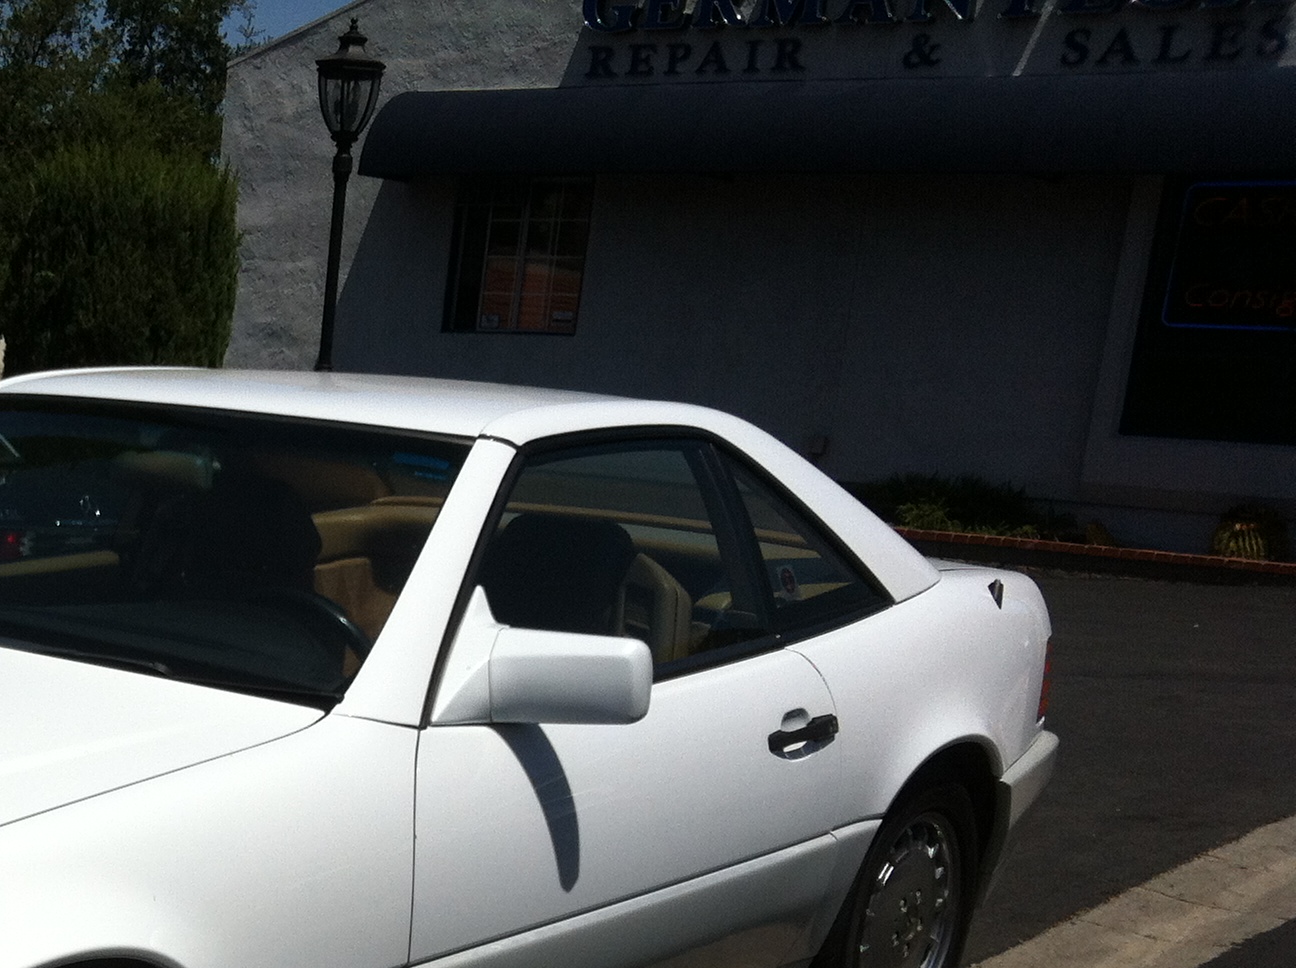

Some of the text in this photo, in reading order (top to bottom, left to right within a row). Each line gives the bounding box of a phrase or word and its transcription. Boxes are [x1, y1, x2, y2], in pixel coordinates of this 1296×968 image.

[586, 17, 1285, 77] REPAIR & SALES
